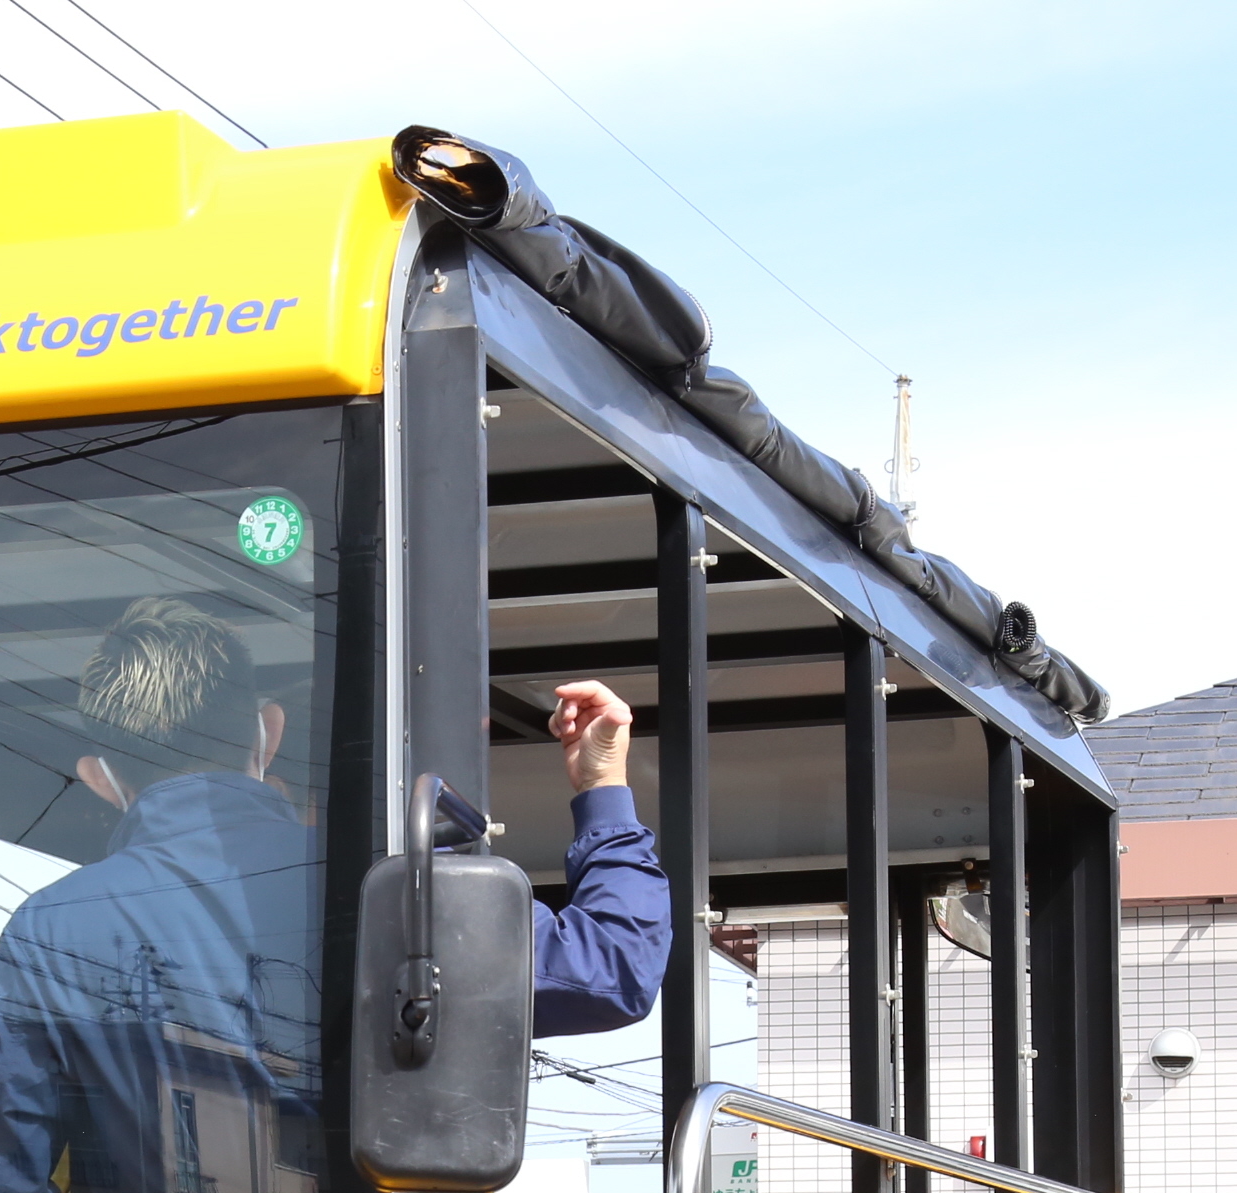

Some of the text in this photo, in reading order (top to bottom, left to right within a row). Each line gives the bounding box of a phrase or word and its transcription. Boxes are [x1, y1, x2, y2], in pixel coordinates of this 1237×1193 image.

[242, 501, 298, 560] 11 12 1 2 3 4 5 6 7 8 9 10
[264, 522, 277, 543] 7
